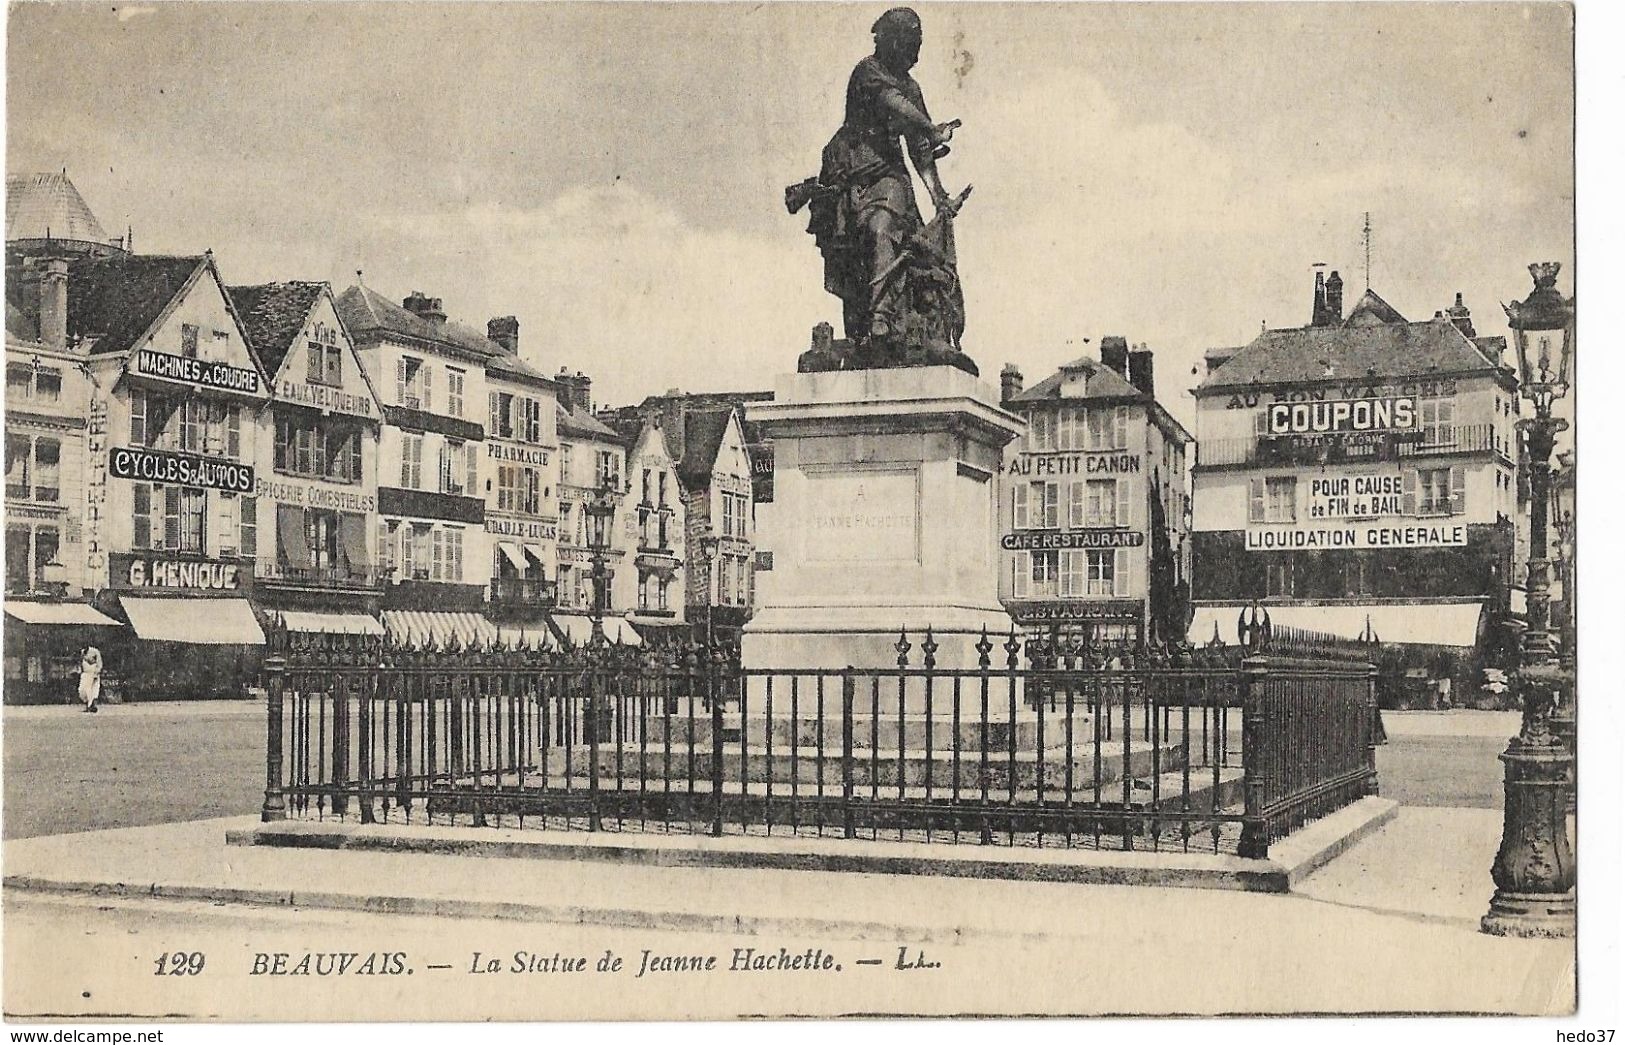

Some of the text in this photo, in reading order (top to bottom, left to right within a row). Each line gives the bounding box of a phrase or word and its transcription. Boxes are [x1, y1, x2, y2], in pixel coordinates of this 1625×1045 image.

[312, 321, 337, 345] VINS
[140, 351, 257, 390] MACHINES A COUDRE
[1226, 392, 1260, 409] AU
[1271, 399, 1414, 433] COUPONS
[488, 443, 549, 466] PHARMACIE
[1009, 455, 1140, 475] AU PETIT CANON
[115, 451, 190, 482] CYCLES
[197, 460, 250, 489] AUTOS
[1312, 476, 1402, 497] POUR CAUSE
[308, 486, 375, 512] COMESTIBLES
[1312, 496, 1402, 517] de FIN de BAIL
[1043, 533, 1140, 548] RESTAURANT
[1249, 530, 1355, 548] LIQUIDATION
